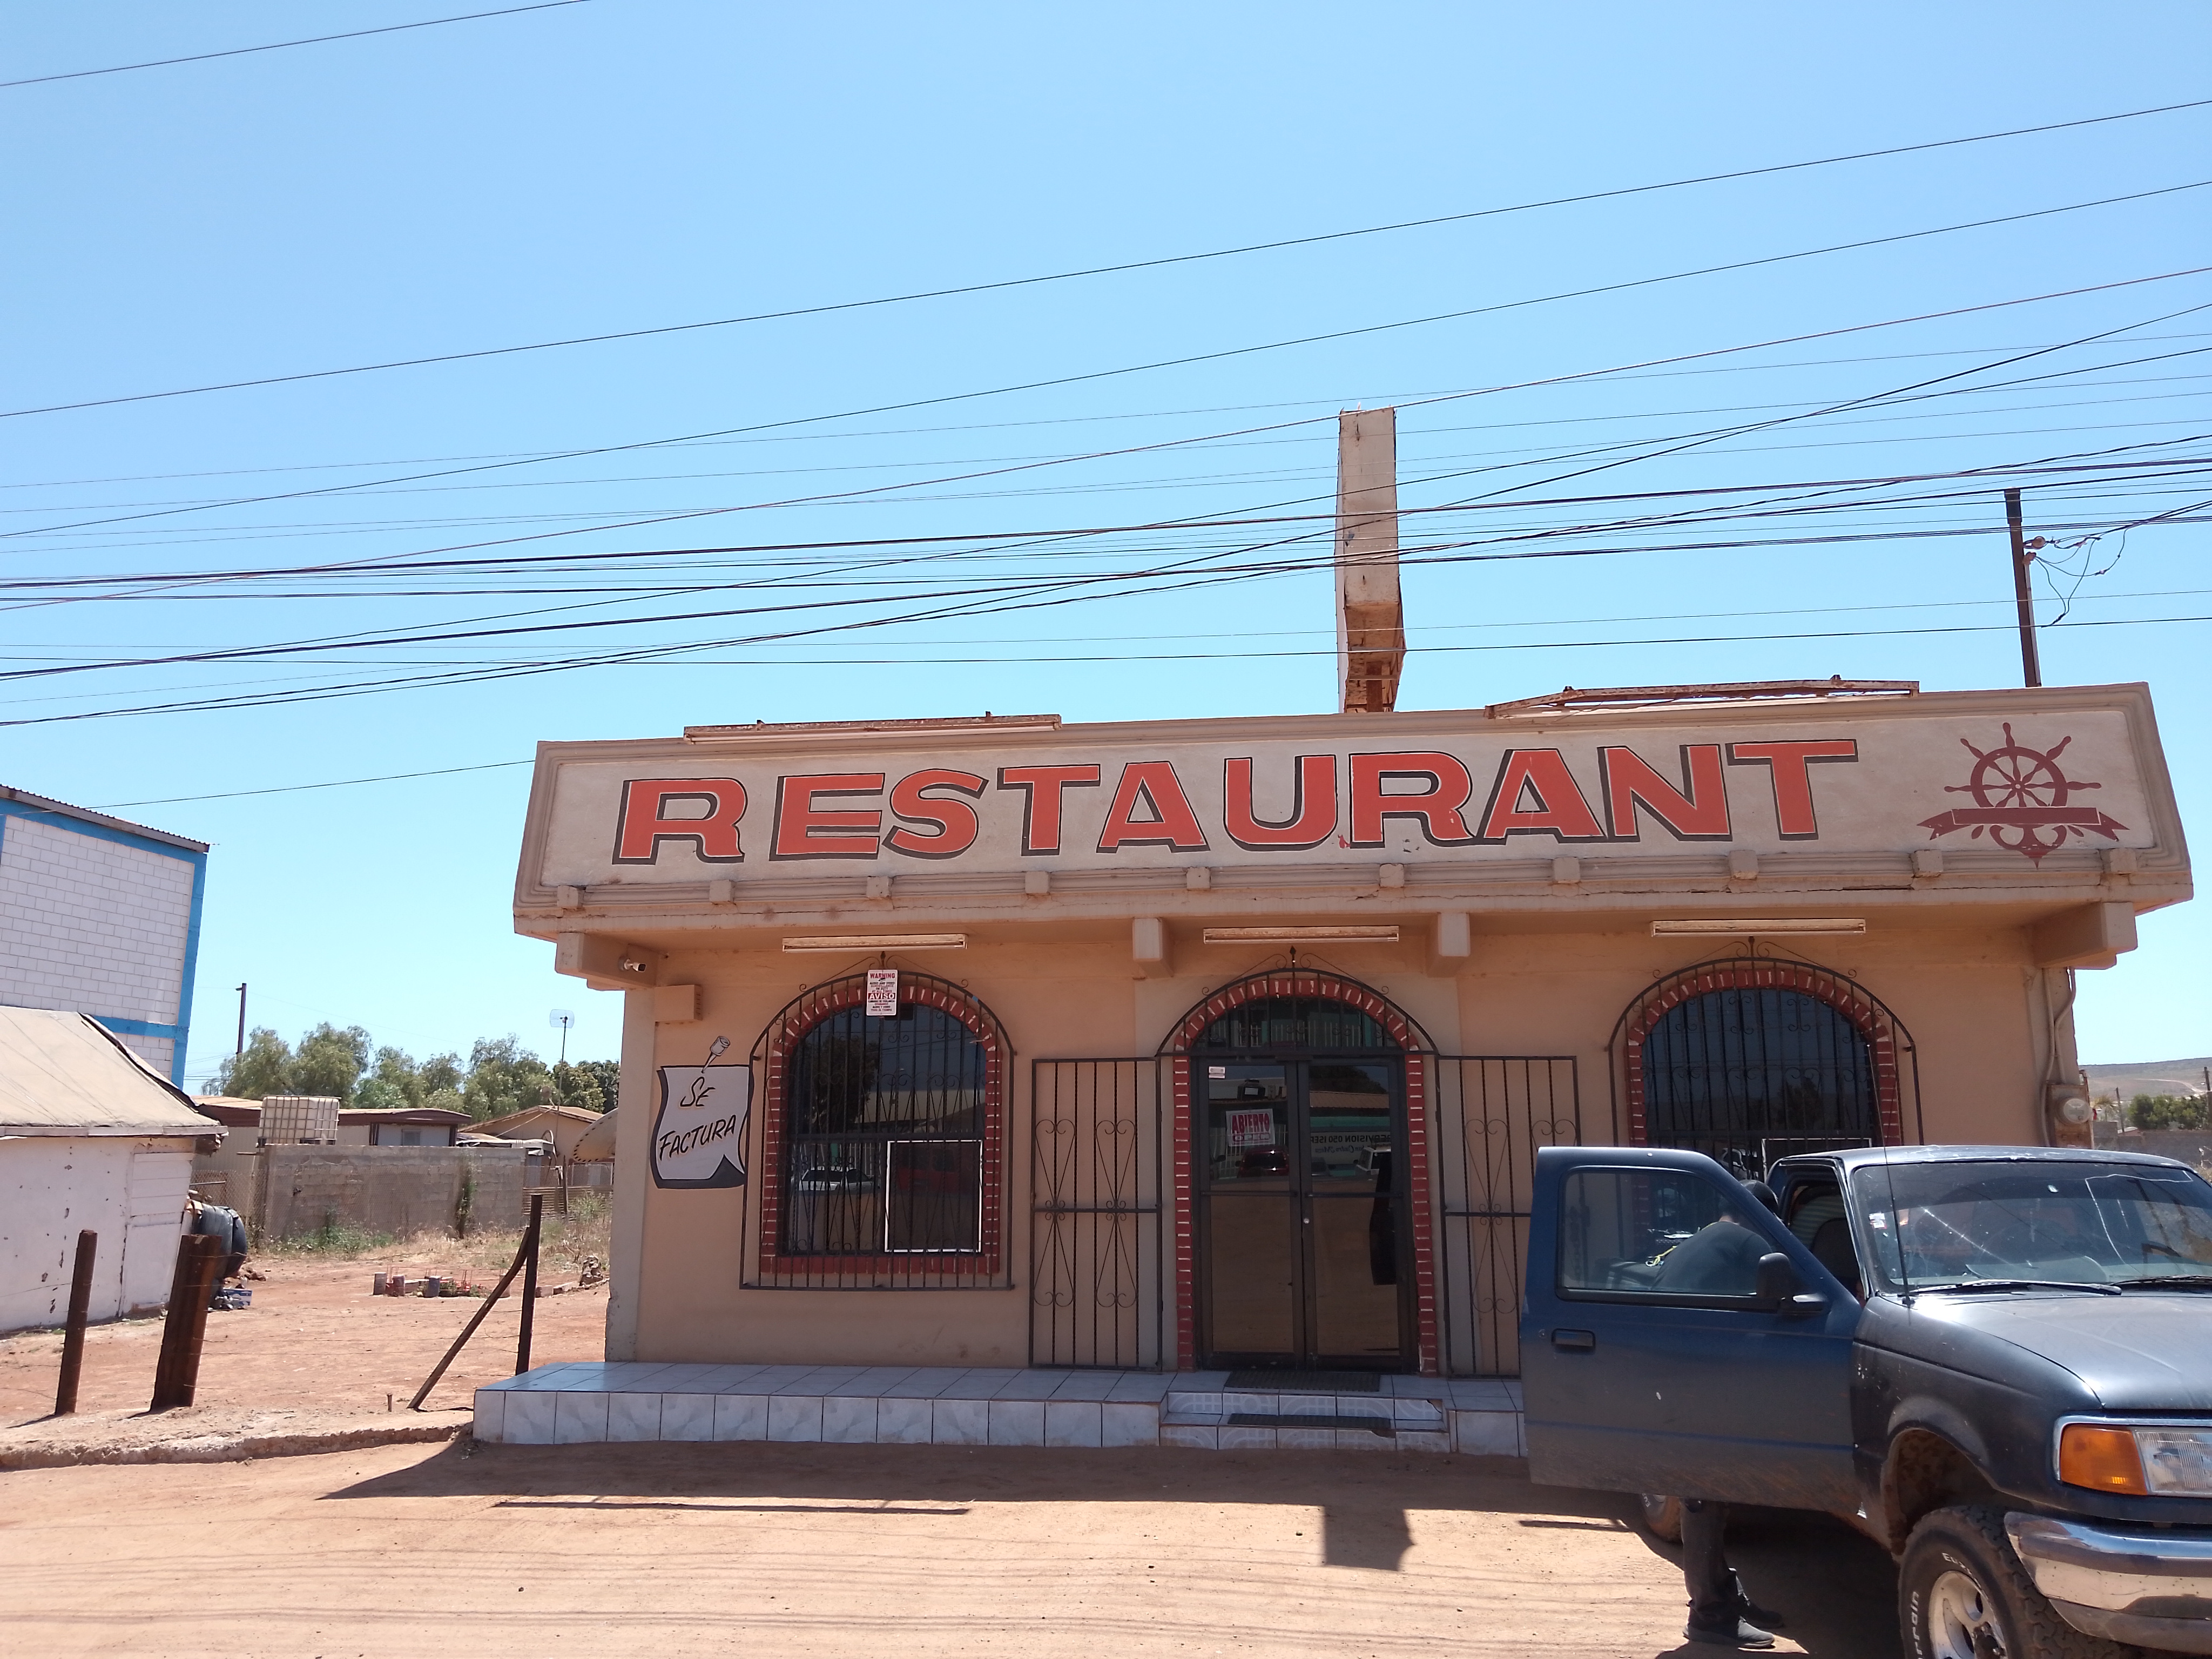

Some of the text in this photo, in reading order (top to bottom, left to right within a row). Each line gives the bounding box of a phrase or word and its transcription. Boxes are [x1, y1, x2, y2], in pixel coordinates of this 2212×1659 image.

[612, 739, 1858, 865] RESTAURANT
[659, 1114, 737, 1161] FACTURA
[1232, 1112, 1270, 1134] ABIERTO
[1232, 1132, 1270, 1142] OPEN
